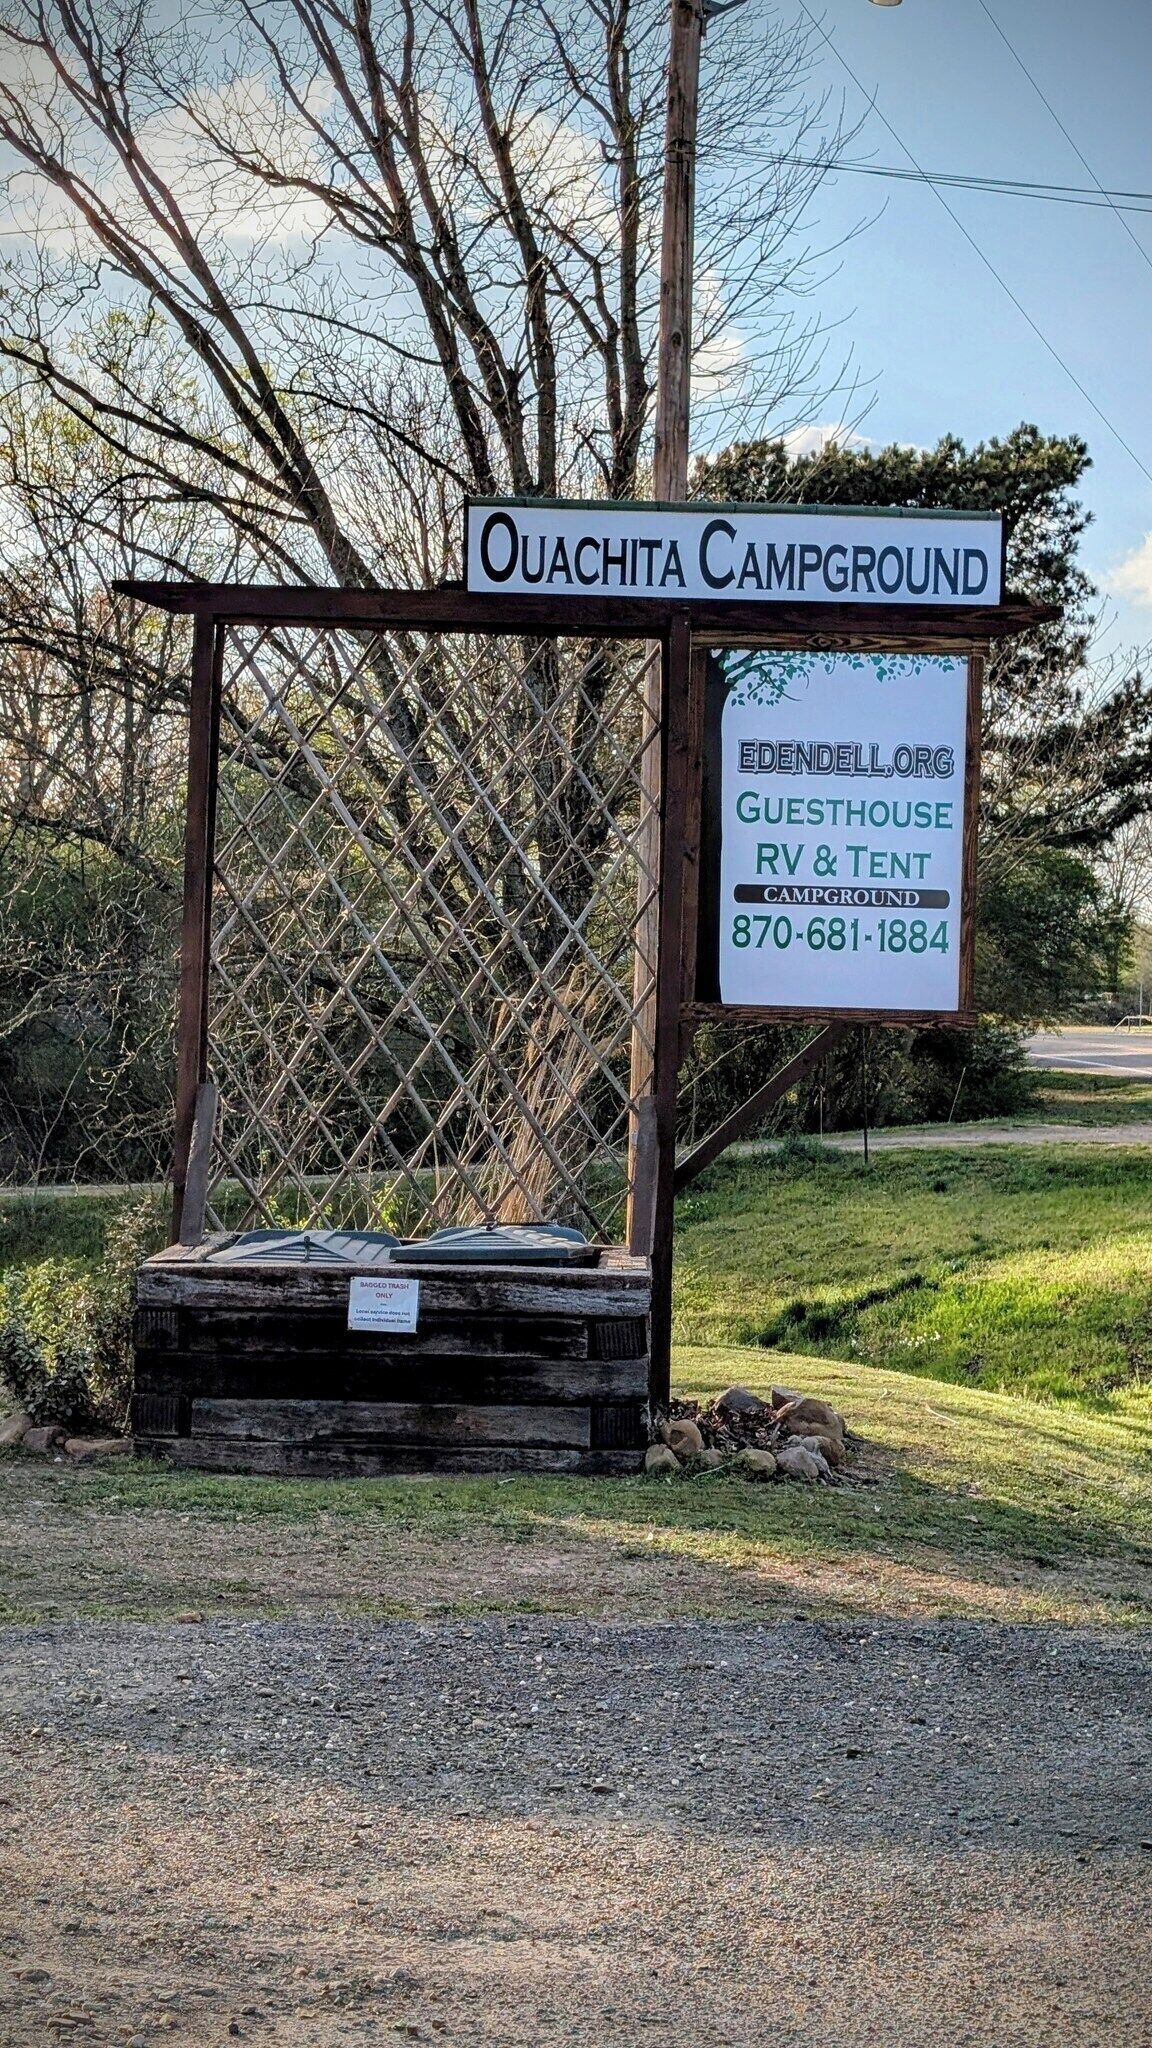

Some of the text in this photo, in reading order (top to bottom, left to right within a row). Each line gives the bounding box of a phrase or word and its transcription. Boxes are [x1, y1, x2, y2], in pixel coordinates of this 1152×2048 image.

[480, 511, 989, 596] OUACHITA CAMPGROUND
[737, 739, 955, 779] EDENDELL.ORG
[736, 791, 954, 830] GUESTHOUSE
[756, 843, 932, 880] RV & TENT
[763, 886, 920, 907] CAMPGROUND
[360, 1281, 409, 1290] BAGGED TRASH
